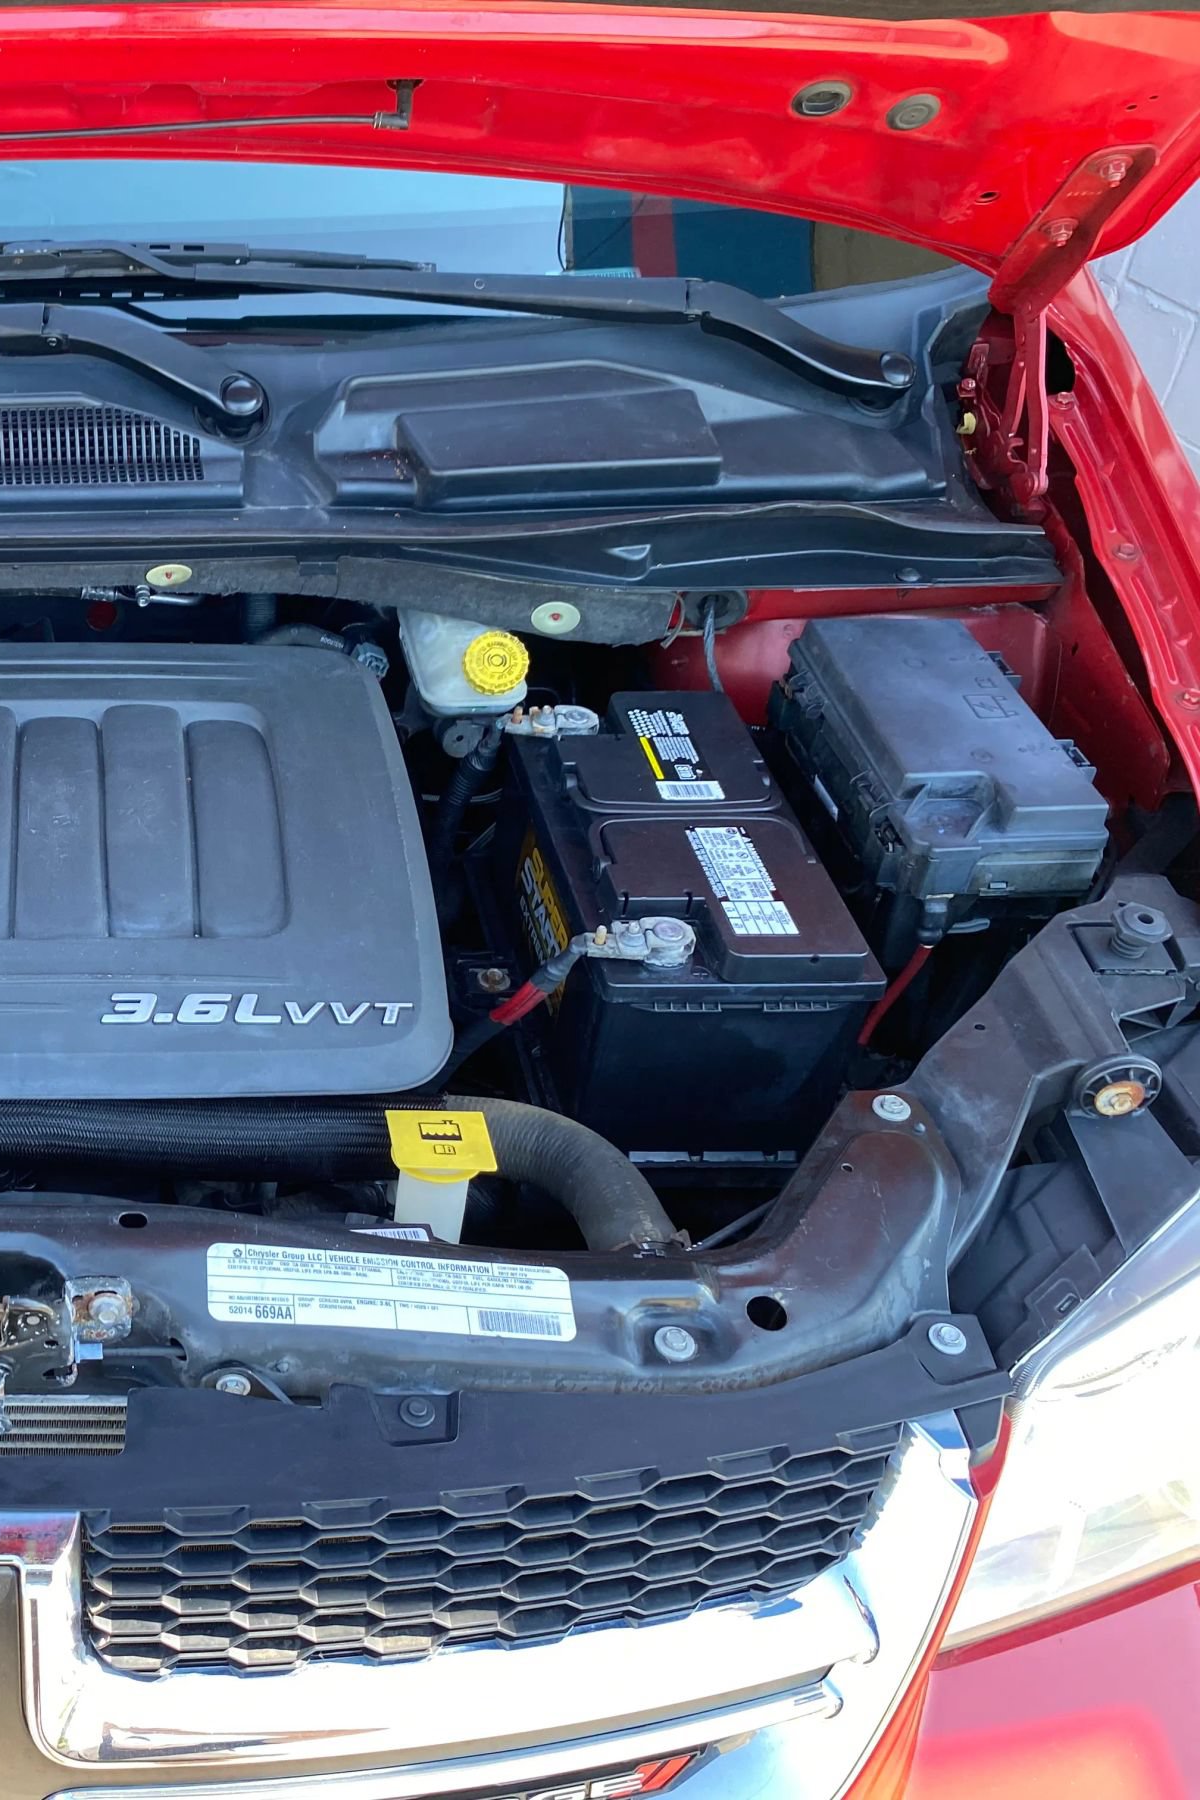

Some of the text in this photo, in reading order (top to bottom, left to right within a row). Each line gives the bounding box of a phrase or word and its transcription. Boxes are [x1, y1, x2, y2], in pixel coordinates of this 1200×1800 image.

[521, 857, 561, 959] START
[532, 847, 568, 951] SUPER
[100, 992, 414, 1025] 3.6L VVT
[247, 1249, 323, 1262] Chrysler Group LLC
[328, 1254, 360, 1265] VEHICLE
[362, 1256, 398, 1267] EMISSION
[400, 1259, 435, 1270] CONTROL
[437, 1262, 490, 1274] INFORMATION
[229, 1305, 253, 1314] 52014
[255, 1304, 292, 1320] 669AA
